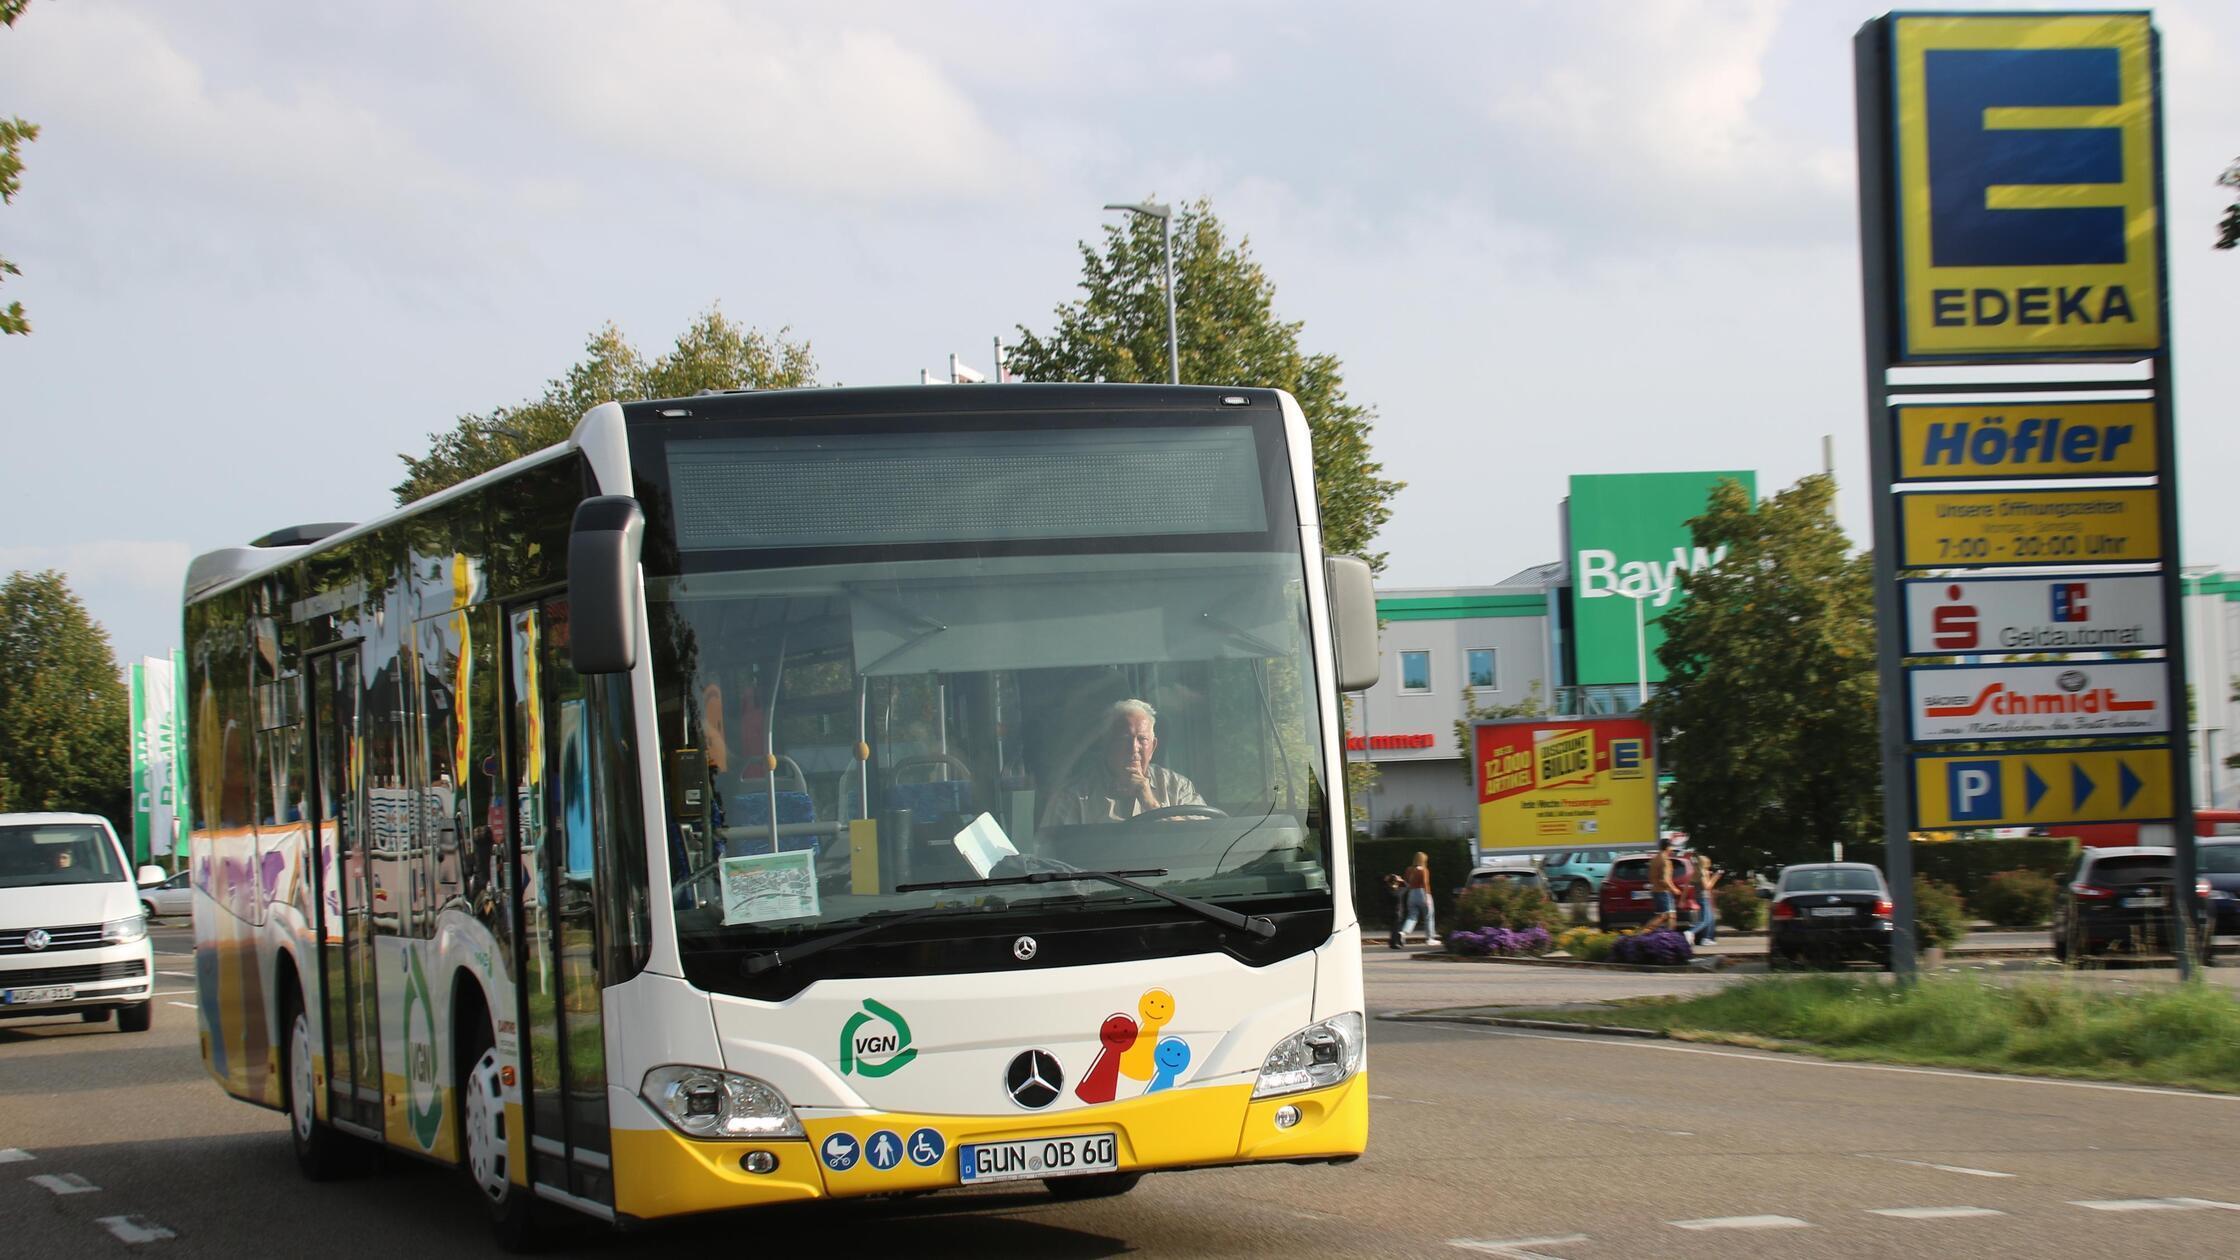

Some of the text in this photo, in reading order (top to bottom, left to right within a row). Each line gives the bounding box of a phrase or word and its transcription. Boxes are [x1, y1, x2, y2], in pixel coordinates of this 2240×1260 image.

[1930, 286, 2136, 327] EDEKA
[1922, 416, 2134, 465] Höfler
[1936, 498, 2124, 518] Unsere Öffnungszeiten
[2012, 535, 2081, 557] 20:00
[2085, 534, 2128, 555] Uhr
[1578, 546, 1729, 607] BayW
[2000, 625, 2144, 648] Geldautomat
[1924, 682, 2156, 718] Schmidt
[1541, 736, 1588, 759] DISCOUNT
[1542, 749, 1588, 780] BILLIG
[1958, 769, 1990, 813] P
[856, 1035, 896, 1054] VGN
[976, 1145, 1026, 1174] GUN
[1043, 1142, 1075, 1168] OB
[1082, 1139, 1113, 1164] 60
